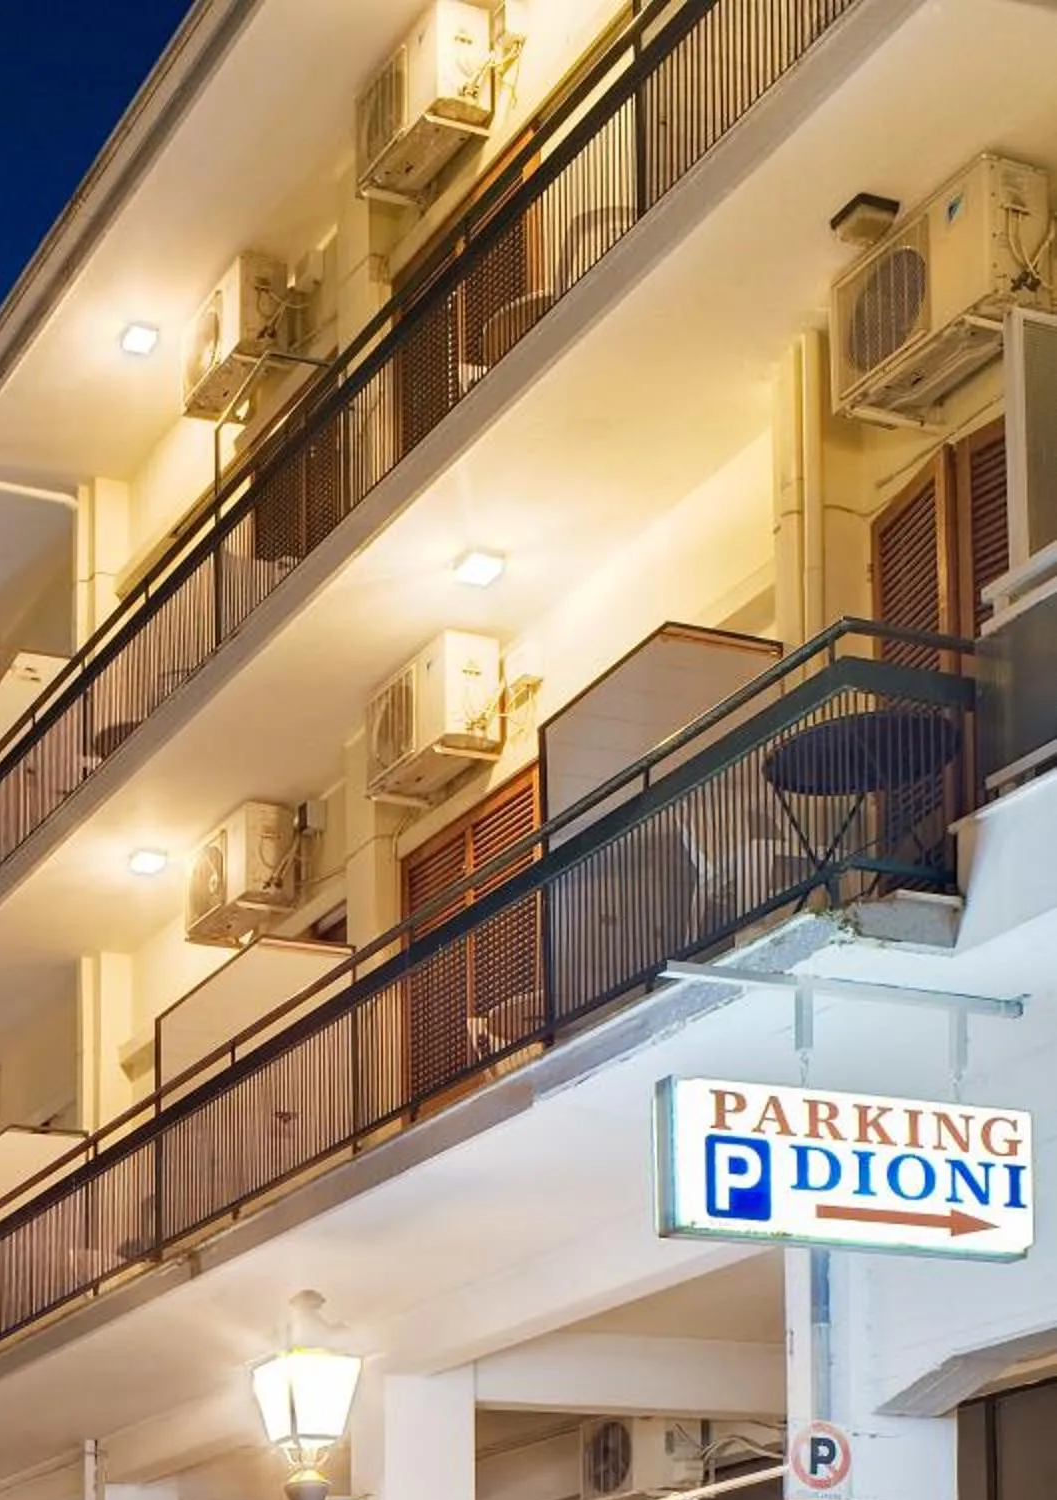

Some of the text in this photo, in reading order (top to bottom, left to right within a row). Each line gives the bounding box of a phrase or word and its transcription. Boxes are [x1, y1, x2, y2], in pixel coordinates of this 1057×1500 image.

[709, 1089, 1022, 1157] PARKING
[713, 1140, 1027, 1213] P DIONI
[810, 1436, 836, 1475] P
